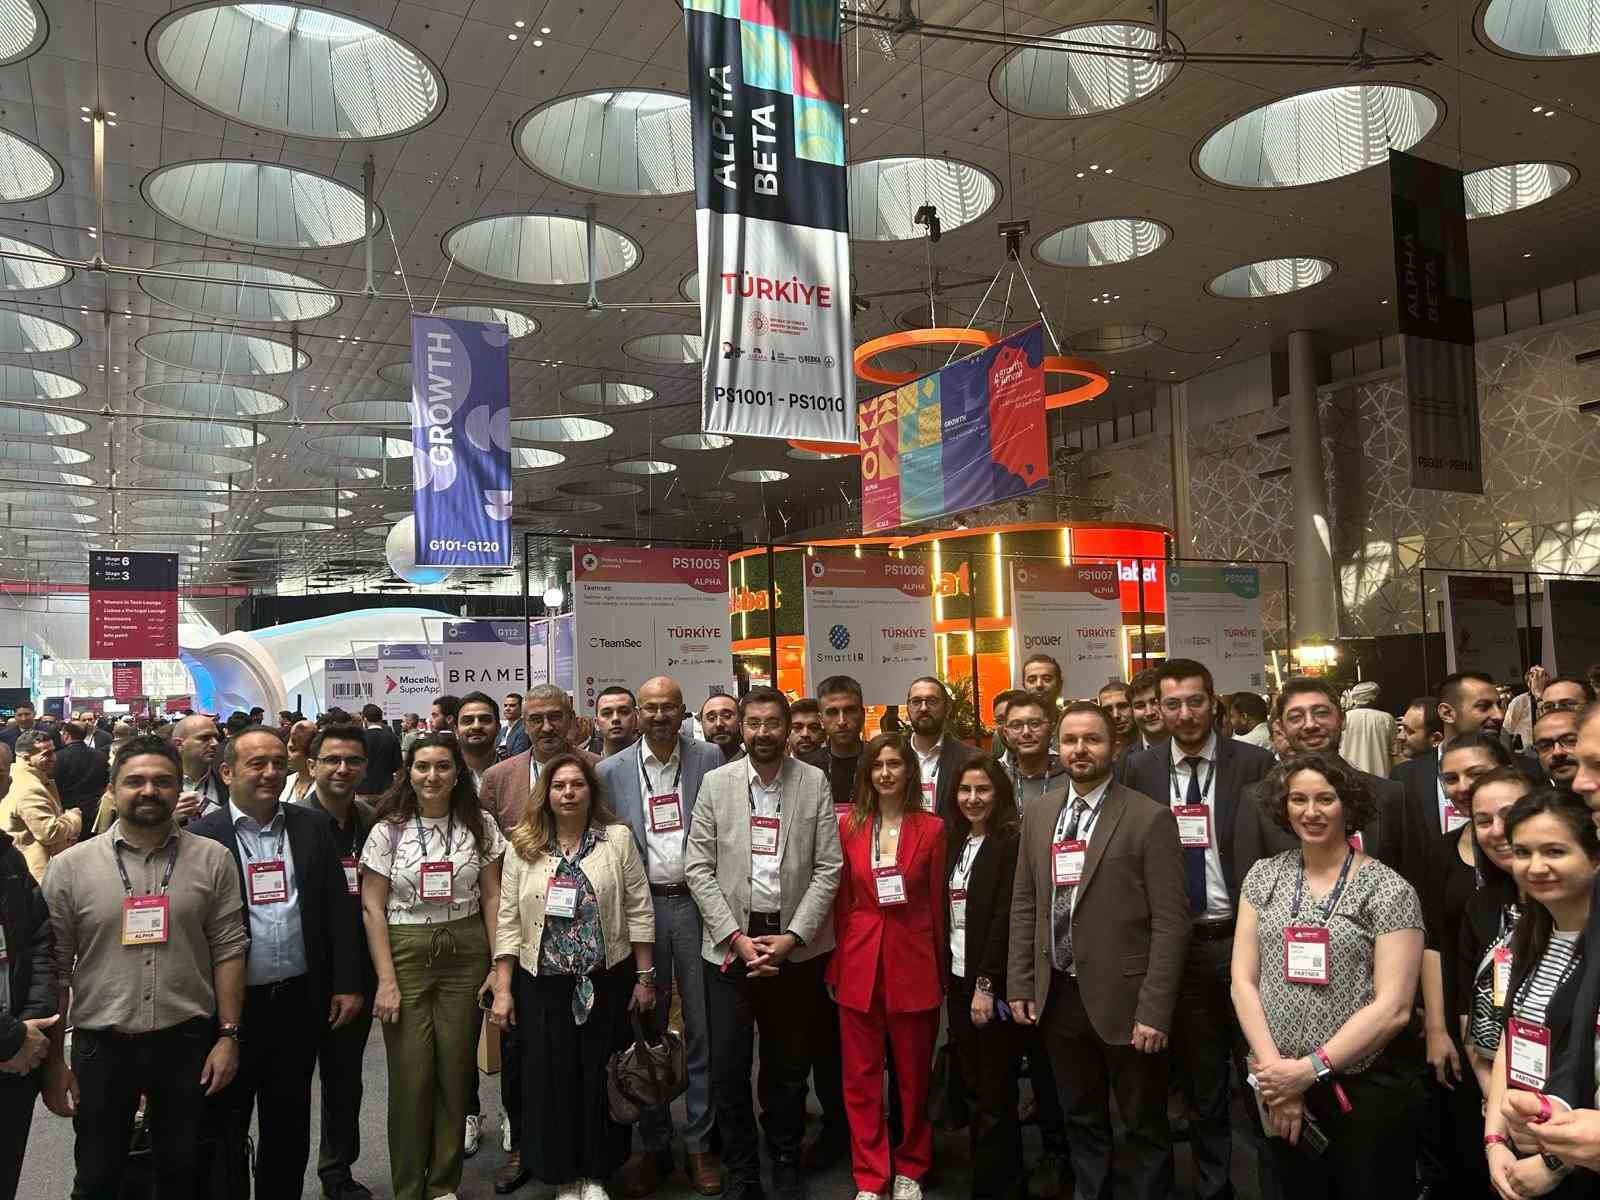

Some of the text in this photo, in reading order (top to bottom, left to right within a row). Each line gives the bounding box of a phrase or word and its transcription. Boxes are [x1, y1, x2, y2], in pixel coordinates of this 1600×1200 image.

[709, 65, 737, 190] ALPHA
[751, 104, 779, 196] BETA
[720, 270, 832, 308] TÜRKİYE
[427, 332, 453, 466] GROWTH
[714, 387, 773, 406] PS1001
[789, 393, 845, 412] PS1010
[430, 539, 500, 552] G101-G120
[121, 556, 130, 566] 6
[672, 557, 721, 570] PS1005
[121, 571, 130, 580] 3
[884, 564, 926, 576] PS1006
[1078, 570, 1113, 581] PS1007
[694, 578, 721, 586] ALPHA
[667, 626, 721, 638] TÜRKİYE
[881, 626, 928, 638] TÜRKİYE
[1076, 626, 1116, 638] TÜRKİYE
[600, 638, 642, 648] TeamSec
[1514, 1073, 1540, 1087] PARTNER
